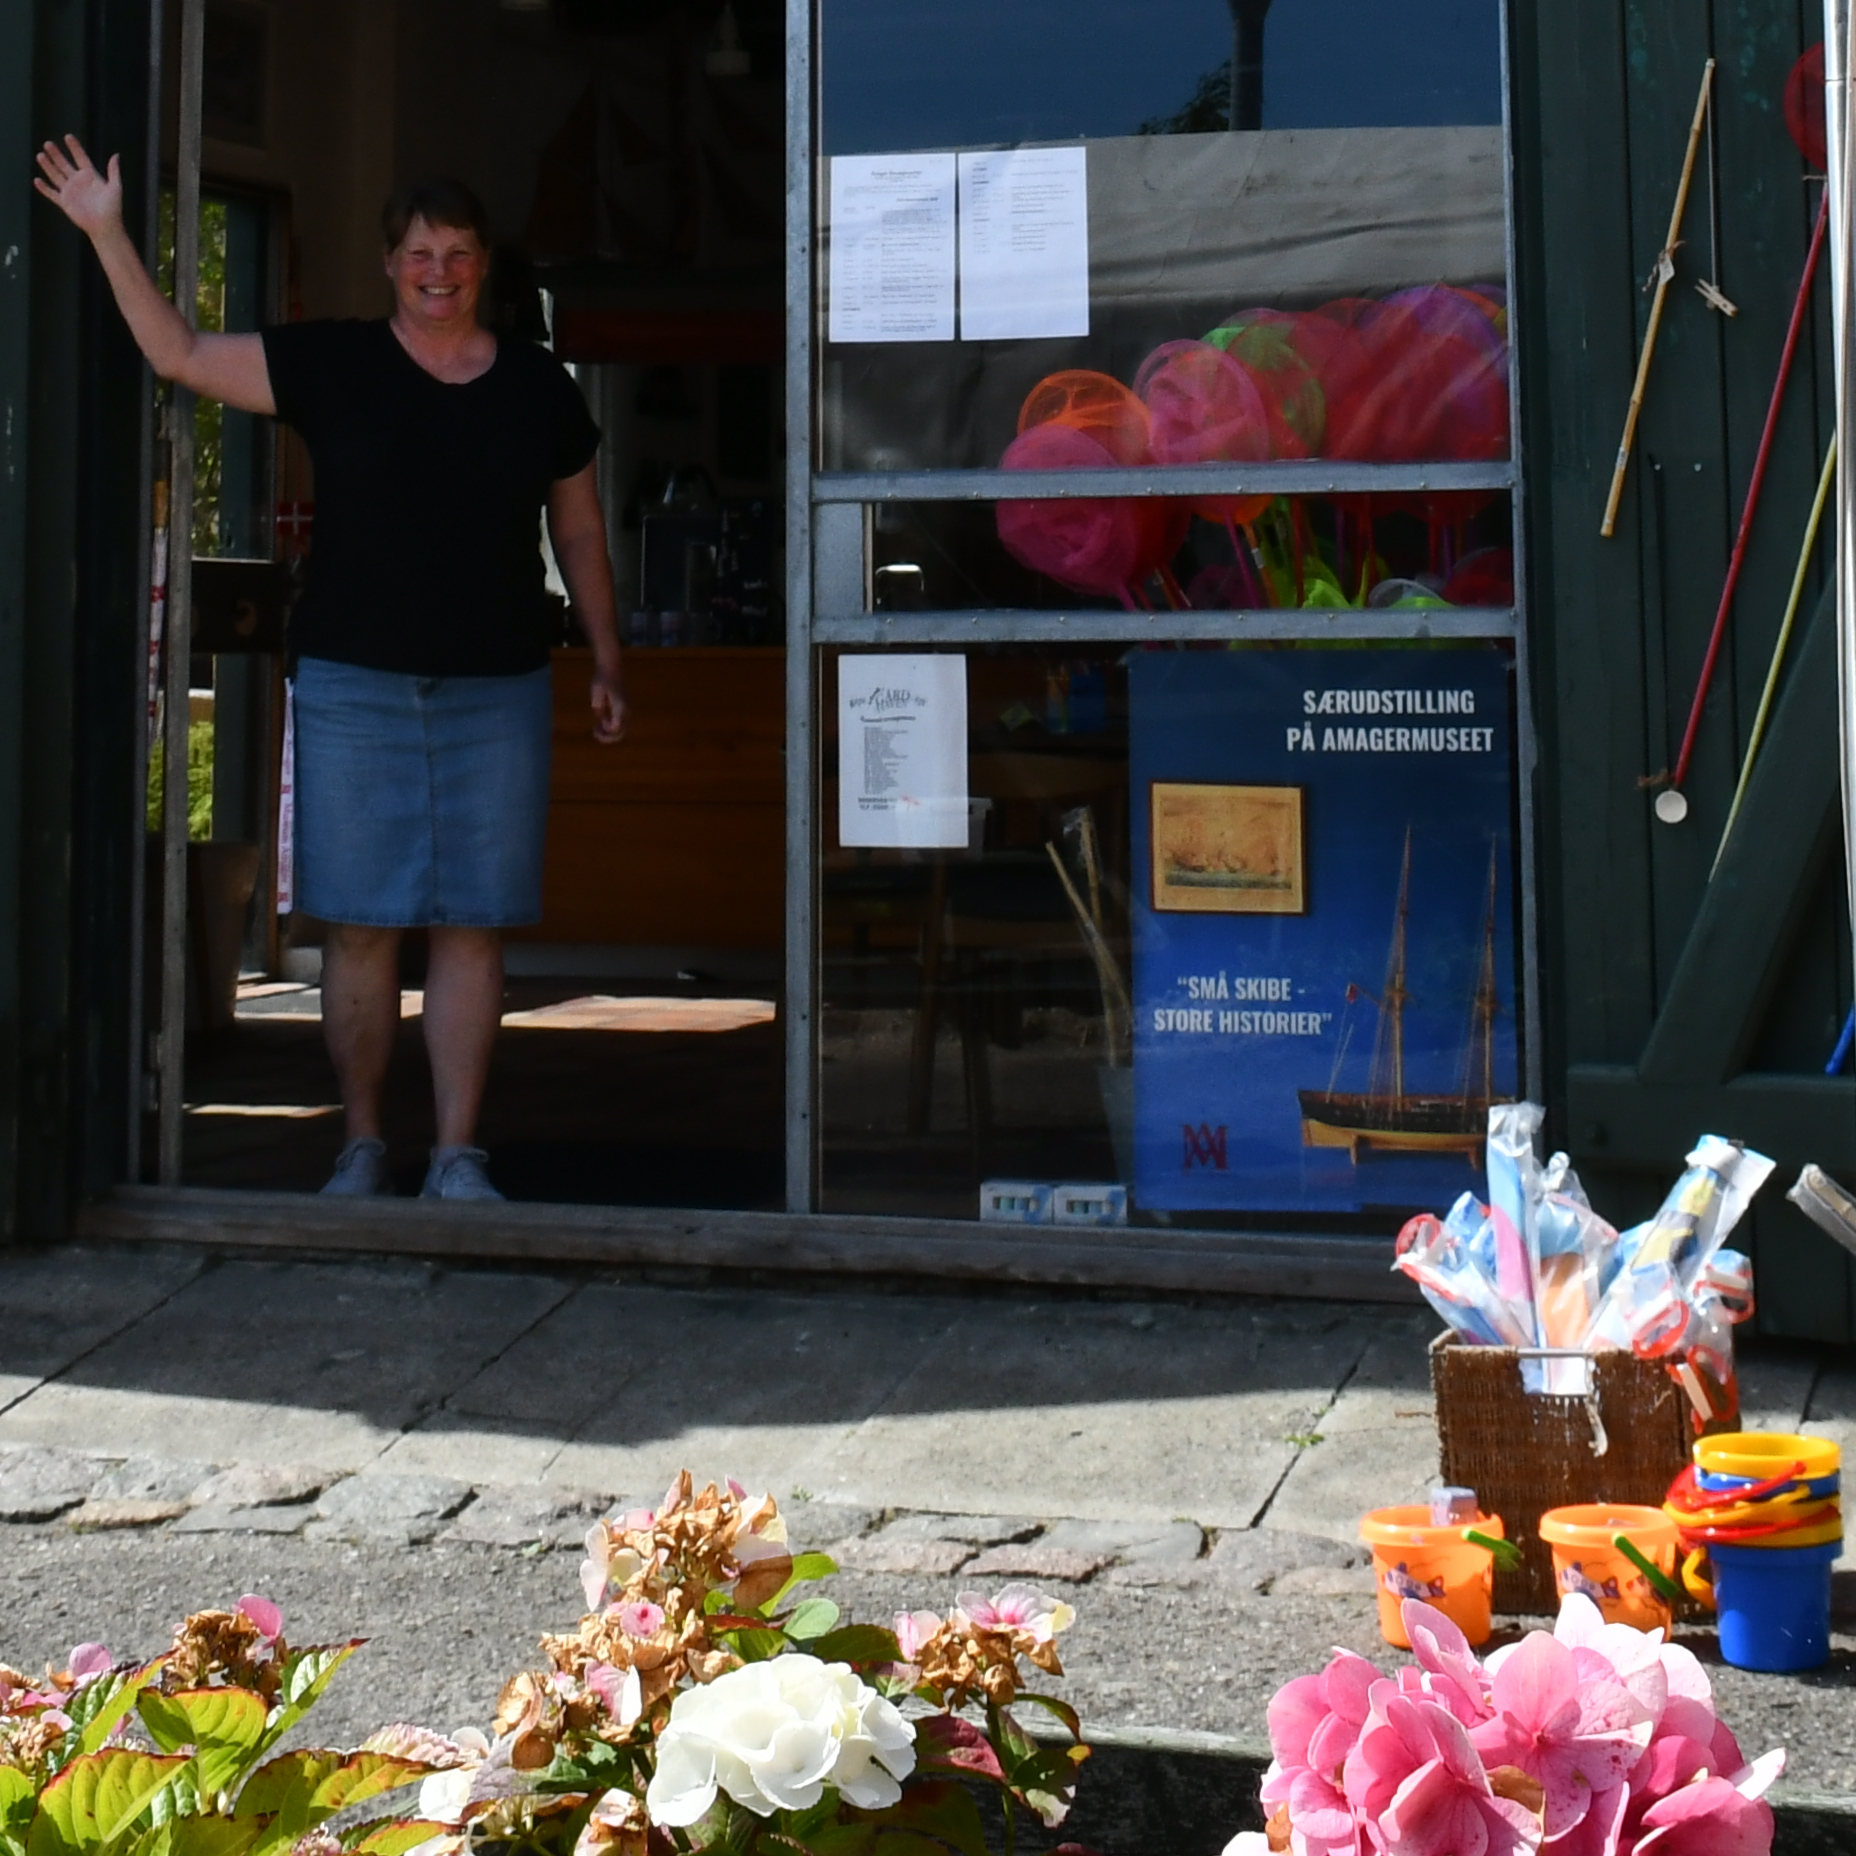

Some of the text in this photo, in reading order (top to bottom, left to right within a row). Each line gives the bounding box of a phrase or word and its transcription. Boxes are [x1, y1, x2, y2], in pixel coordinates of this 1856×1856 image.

[1303, 690, 1475, 714] SÆRUDSTILLING
[1286, 720, 1493, 751] PÅ AMAGERMUSEET
[1234, 977, 1291, 1001] SKIBE
[1153, 1008, 1214, 1033] STORE
